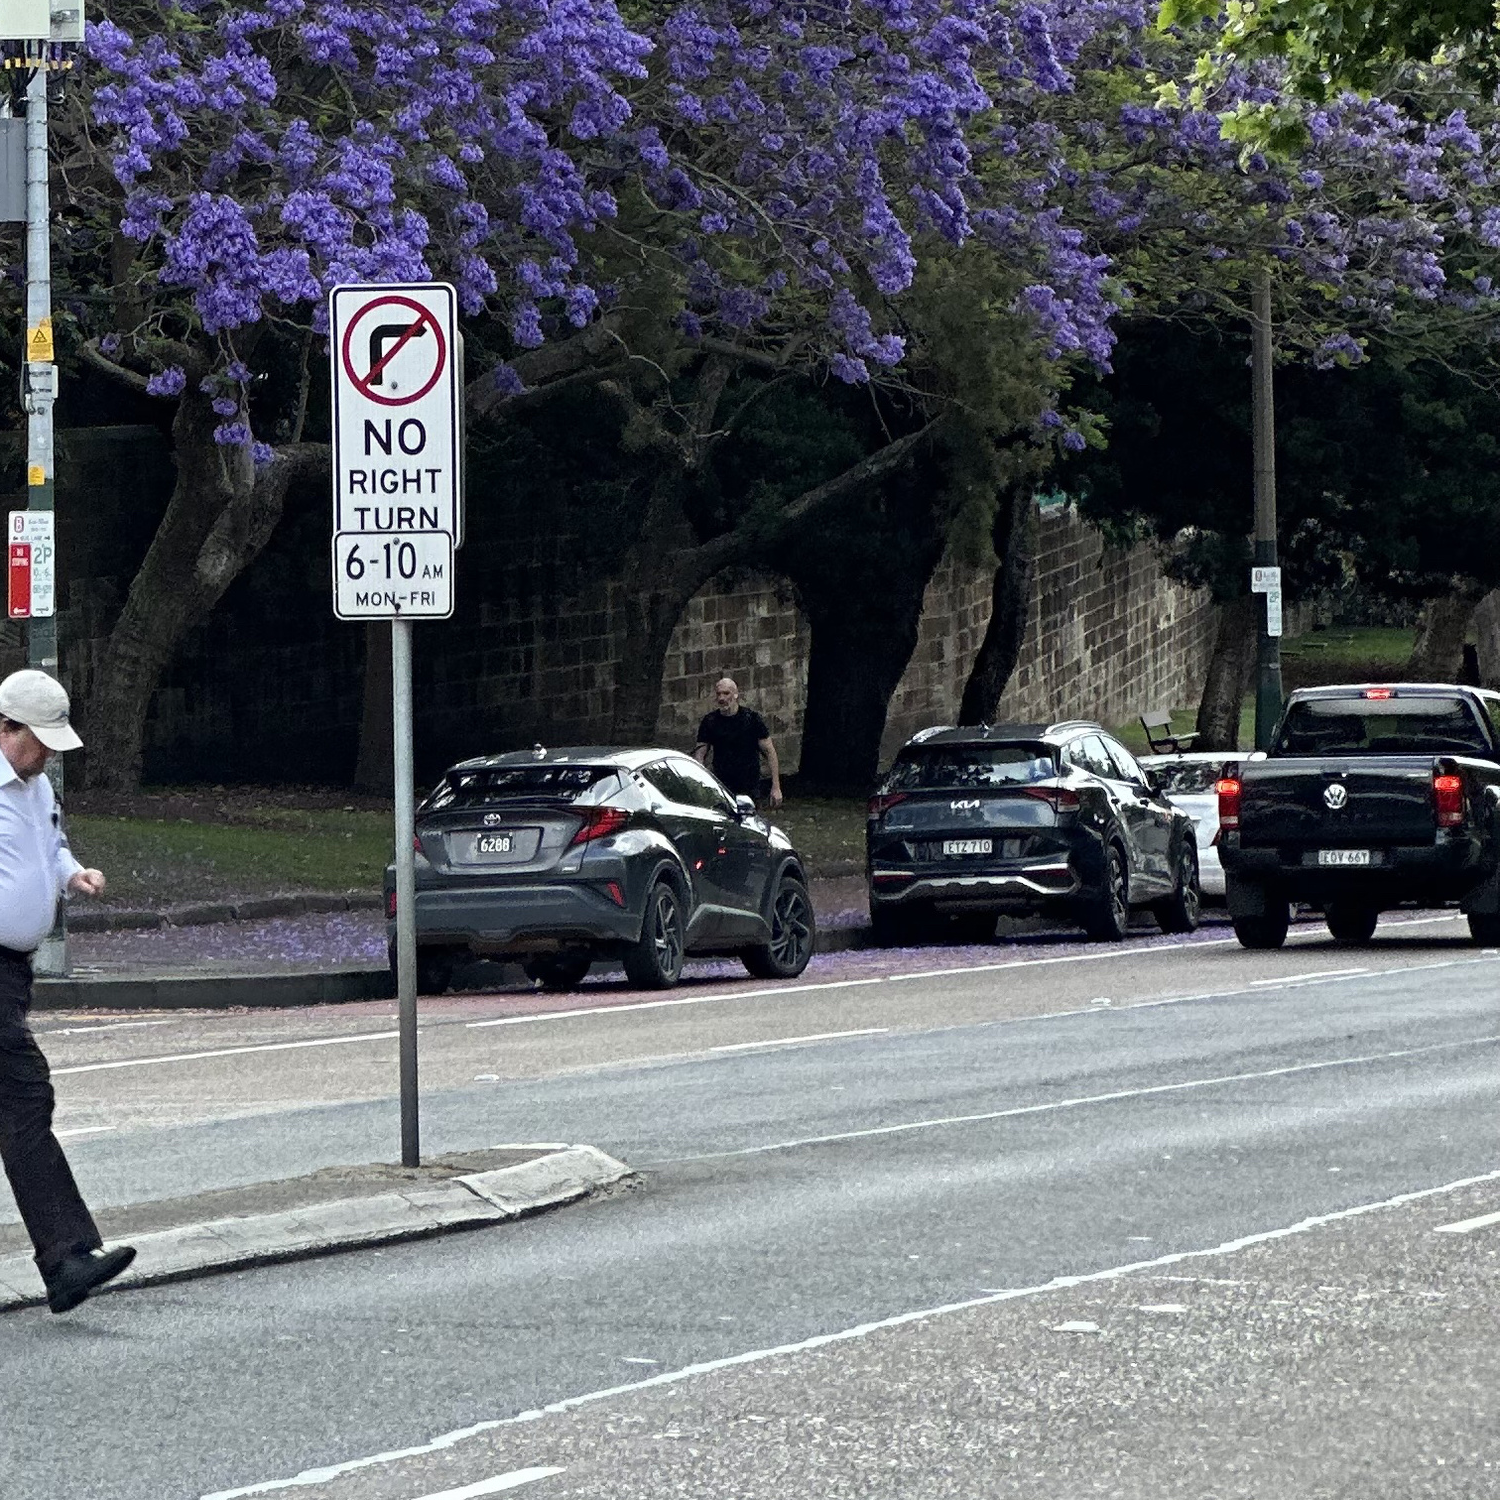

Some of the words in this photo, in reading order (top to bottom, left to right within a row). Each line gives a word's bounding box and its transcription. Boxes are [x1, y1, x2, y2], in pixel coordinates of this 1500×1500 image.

[364, 418, 426, 456] NO
[349, 468, 442, 494] RIGHT
[354, 506, 438, 530] TURN
[34, 547, 52, 564] 2P
[346, 541, 417, 581] 6-10
[422, 564, 443, 579] AM
[356, 591, 436, 607] MON-FRI
[480, 837, 510, 852] 6288
